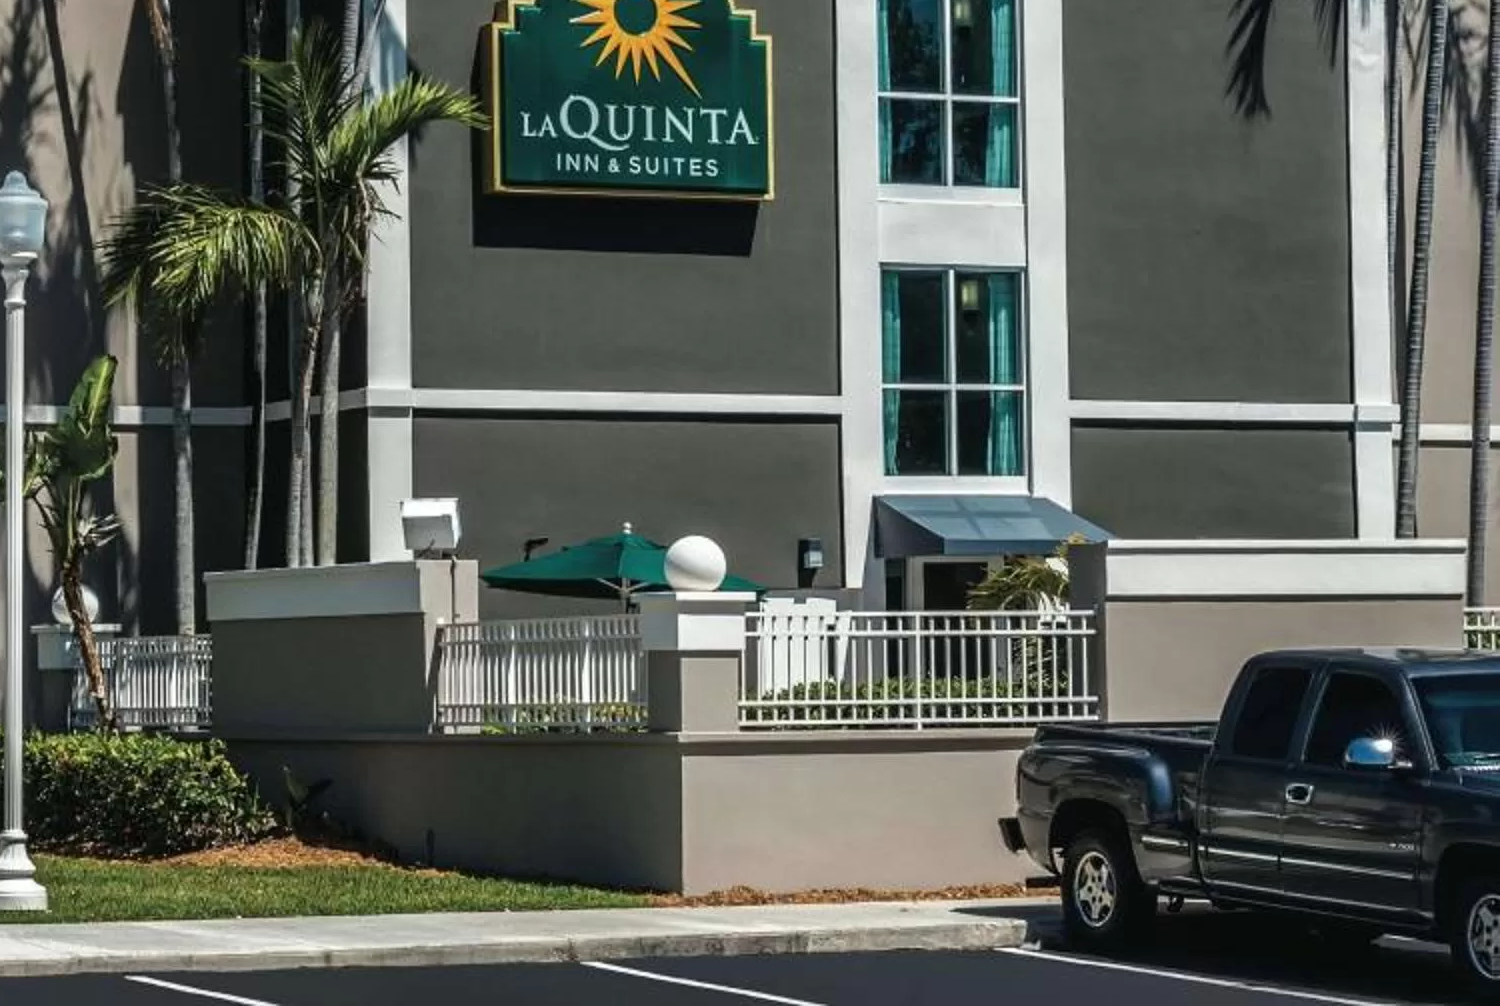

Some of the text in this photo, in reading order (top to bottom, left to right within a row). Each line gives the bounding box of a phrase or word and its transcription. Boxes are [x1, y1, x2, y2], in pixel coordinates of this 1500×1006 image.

[559, 95, 758, 151] QUINTA
[556, 153, 720, 177] INN & SUITES
